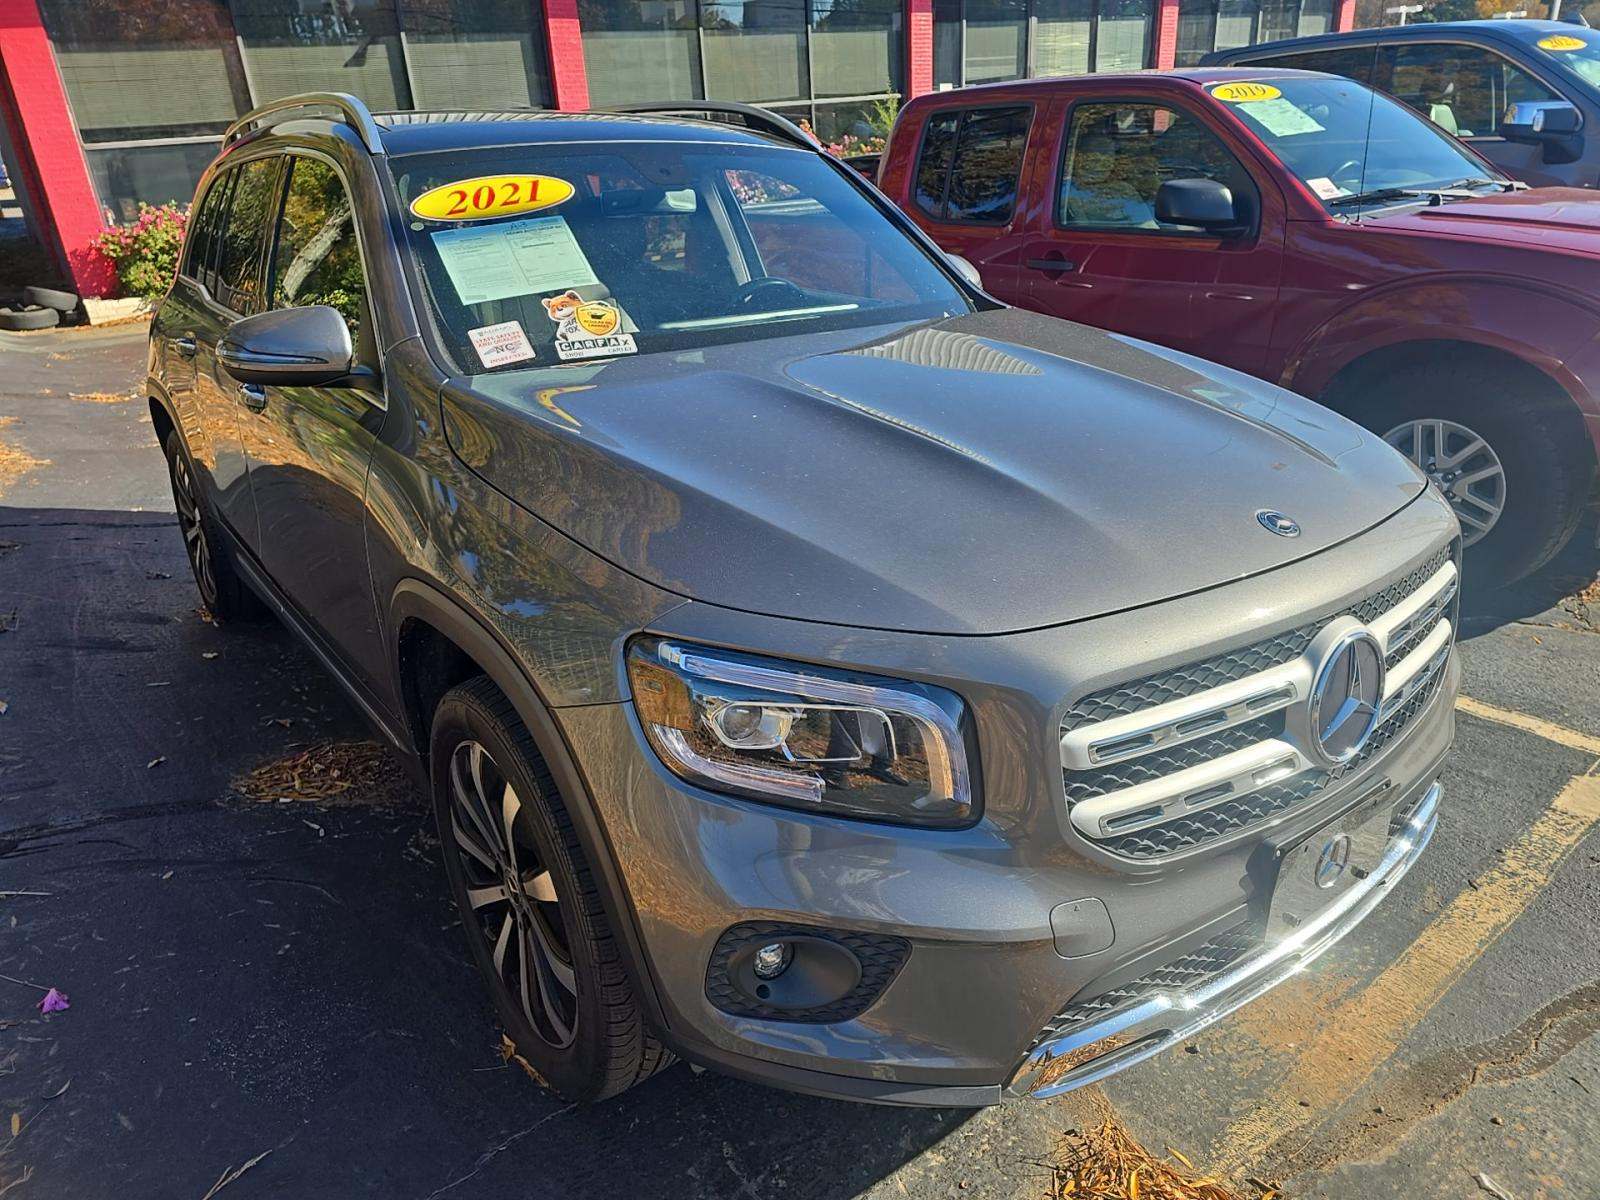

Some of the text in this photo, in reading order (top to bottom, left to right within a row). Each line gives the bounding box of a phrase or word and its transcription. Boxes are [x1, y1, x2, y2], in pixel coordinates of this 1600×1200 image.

[1223, 84, 1267, 99] 2019
[445, 179, 542, 216] 2021
[494, 343, 515, 354] NC
[559, 337, 630, 352] CARFAX
